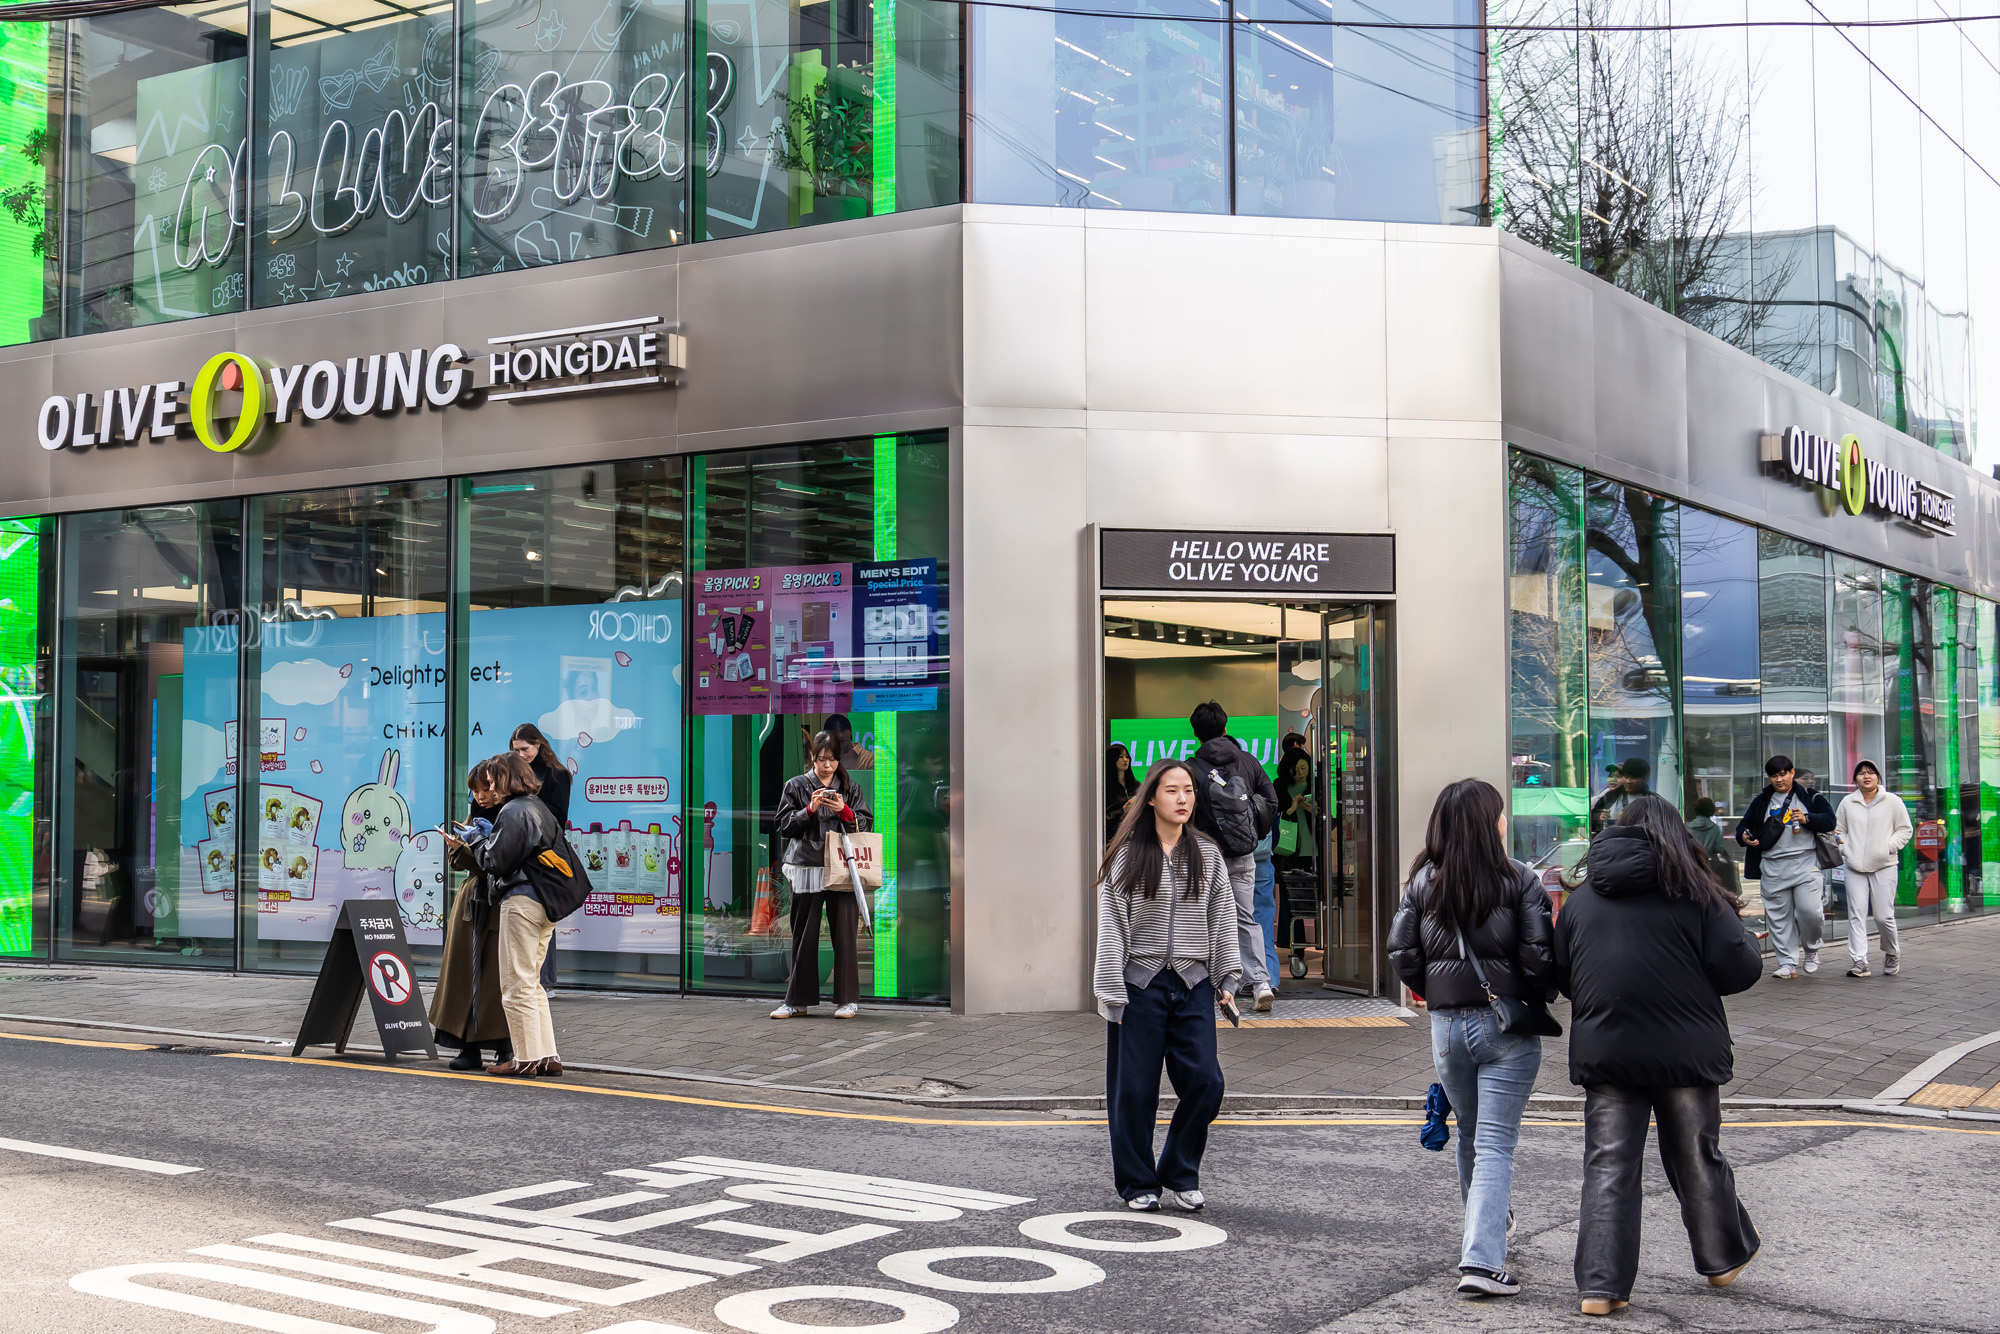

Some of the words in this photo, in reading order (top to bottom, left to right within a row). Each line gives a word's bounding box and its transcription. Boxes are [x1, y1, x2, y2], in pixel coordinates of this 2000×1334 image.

[1161, 21, 1200, 52] Supplement
[38, 382, 182, 451] OLIVE
[270, 344, 466, 423] YOUNG
[489, 333, 657, 384] HONGDAE
[1790, 425, 1841, 491] OLIVE
[1864, 458, 1917, 520] YOUNG
[1921, 495, 1956, 527] HONGDAE
[1171, 541, 1243, 559] HELLO
[1247, 542, 1285, 560] WE
[1288, 543, 1329, 562] ARE
[782, 573, 802, 589] 올영
[803, 572, 830, 587] PICK
[832, 571, 842, 586] 3
[860, 568, 900, 579] MEN'S
[902, 566, 930, 576] EDIT
[1169, 561, 1232, 580] OLIVE
[1239, 564, 1318, 583] YOUNG
[704, 577, 723, 592] 올영
[724, 576, 750, 591] PICK
[752, 575, 761, 589] 3
[867, 578, 898, 592] Special
[901, 577, 924, 588] Price
[371, 664, 432, 689] Delight
[435, 661, 501, 687] pect
[1112, 740, 1196, 767] LIVE
[588, 784, 616, 795] 올리브영
[619, 784, 633, 795] 단독
[637, 784, 666, 795] 특별한정
[591, 894, 615, 902] 프로젝트
[616, 894, 654, 904] 단백질쉐이크
[585, 904, 608, 915] 먼작귀
[610, 905, 633, 915] 에디션
[359, 918, 394, 930] 주차금지
[385, 1021, 399, 1030] OLIVE
[405, 1020, 422, 1029] YOUNG
